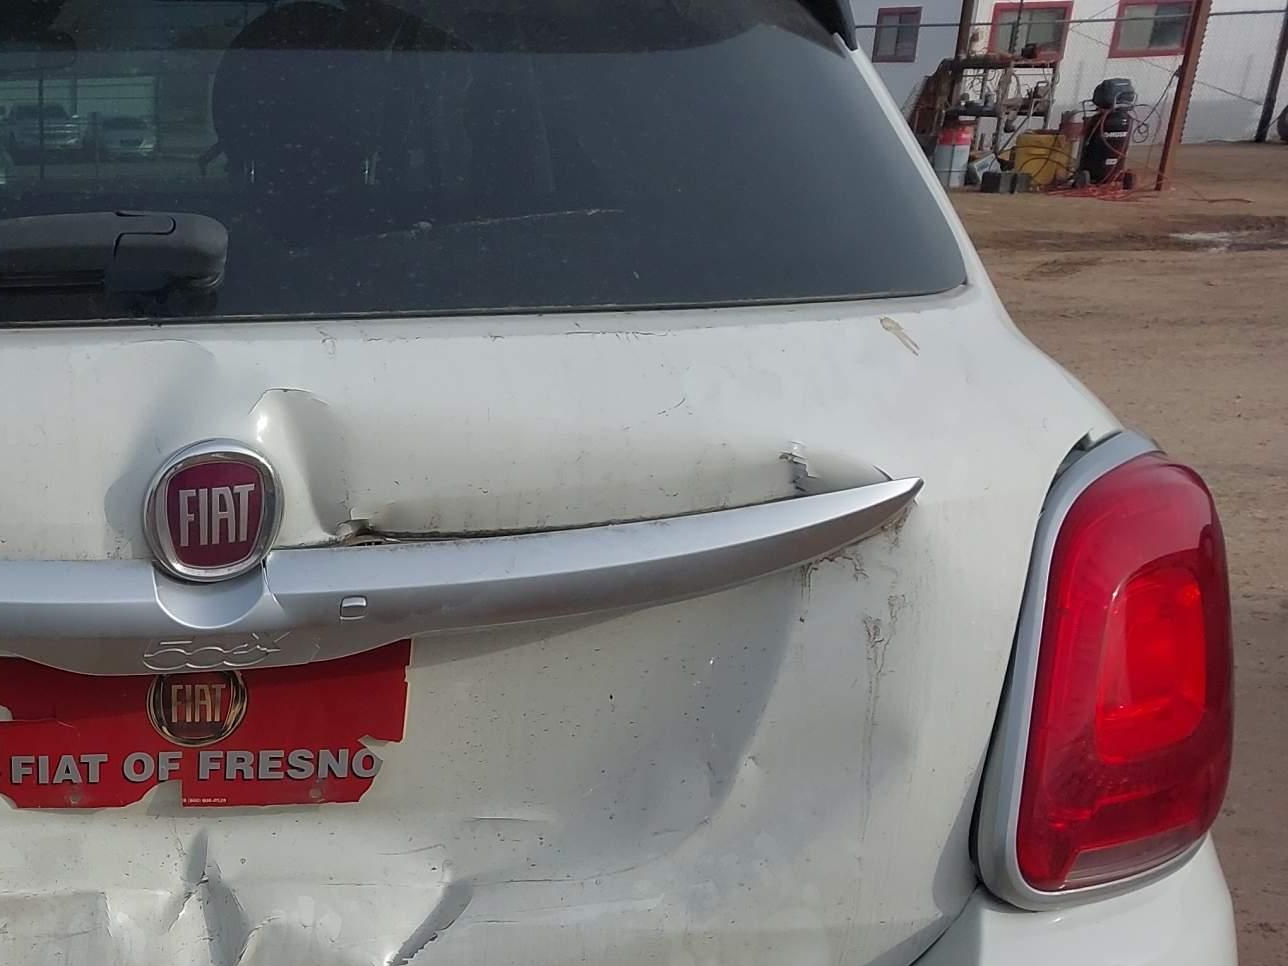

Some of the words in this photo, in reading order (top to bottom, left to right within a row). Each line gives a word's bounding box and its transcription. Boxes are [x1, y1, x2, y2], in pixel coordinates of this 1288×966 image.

[178, 483, 255, 547] FIAT
[171, 683, 226, 723] FIAT
[10, 752, 108, 785] FIAT
[123, 751, 183, 783] OF
[197, 747, 383, 781] FRESNO
